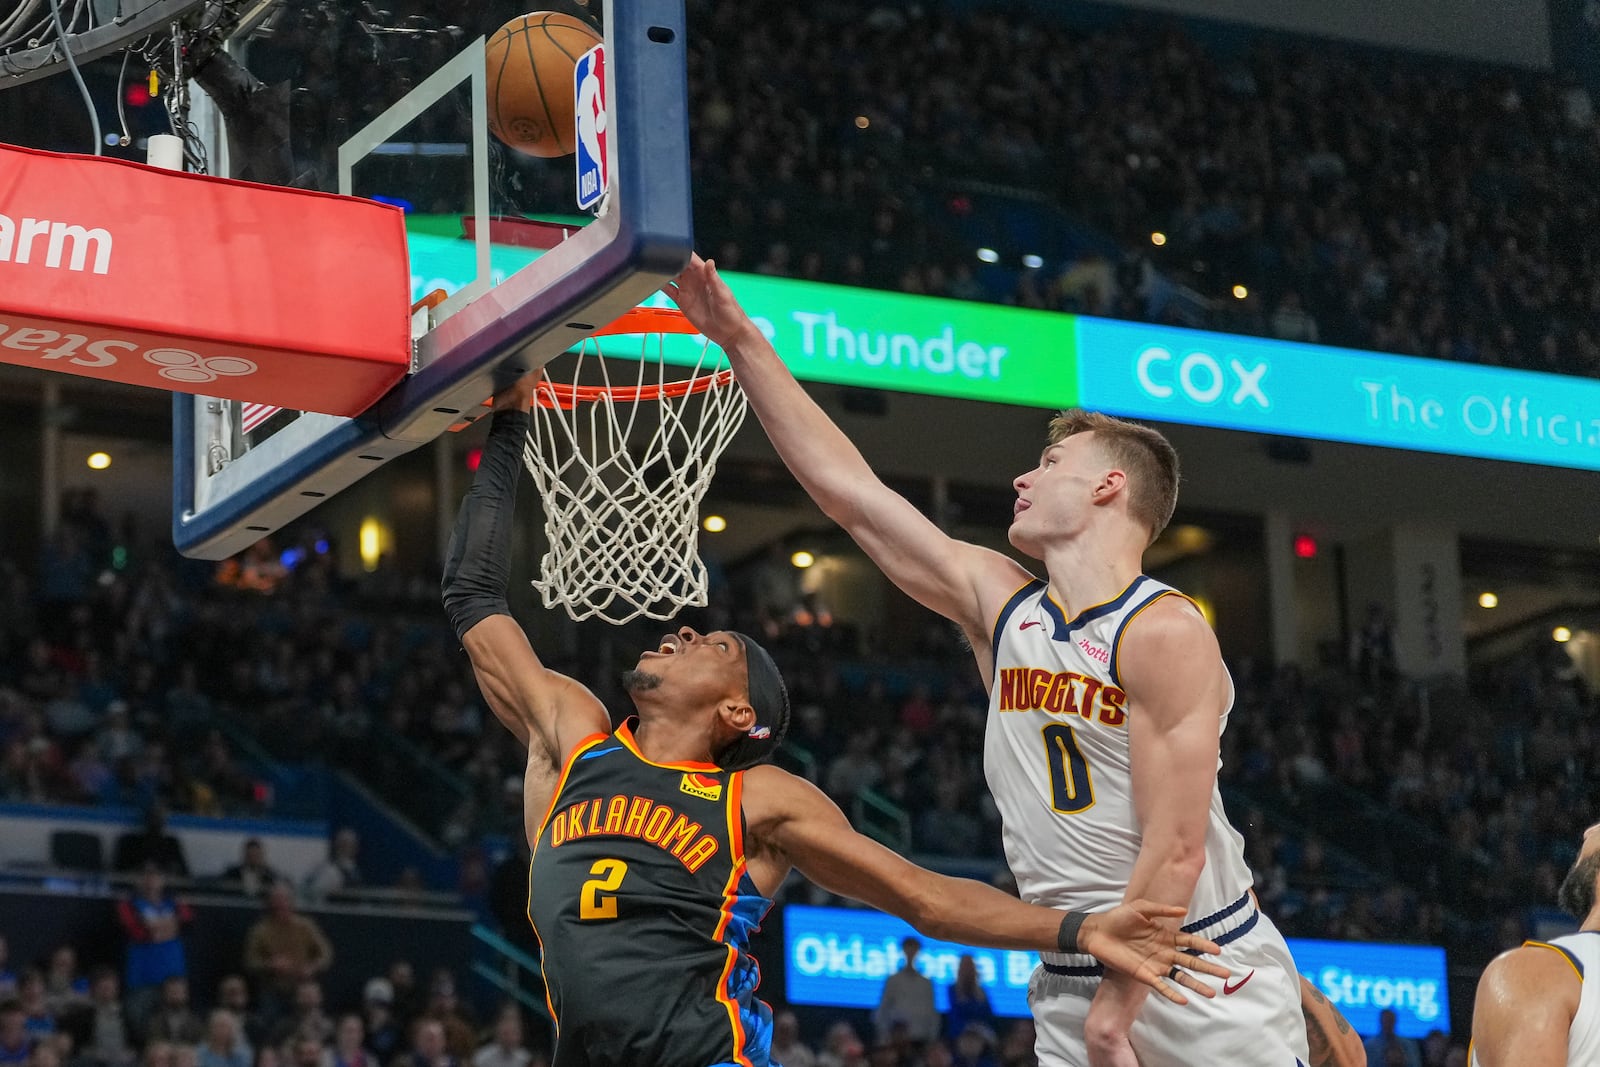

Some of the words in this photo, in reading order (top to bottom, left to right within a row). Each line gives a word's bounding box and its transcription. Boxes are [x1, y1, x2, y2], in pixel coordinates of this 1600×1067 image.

[581, 168, 598, 199] NBA
[0, 323, 139, 368] Sta
[792, 310, 1008, 378] Thunder
[1137, 347, 1270, 408] COX
[1361, 380, 1444, 430] The
[998, 667, 1129, 727] NUGGETS
[1040, 721, 1096, 815] 0
[551, 794, 720, 875] OKLAHOMA
[579, 857, 629, 920] 2
[1322, 968, 1440, 1018] Strong
